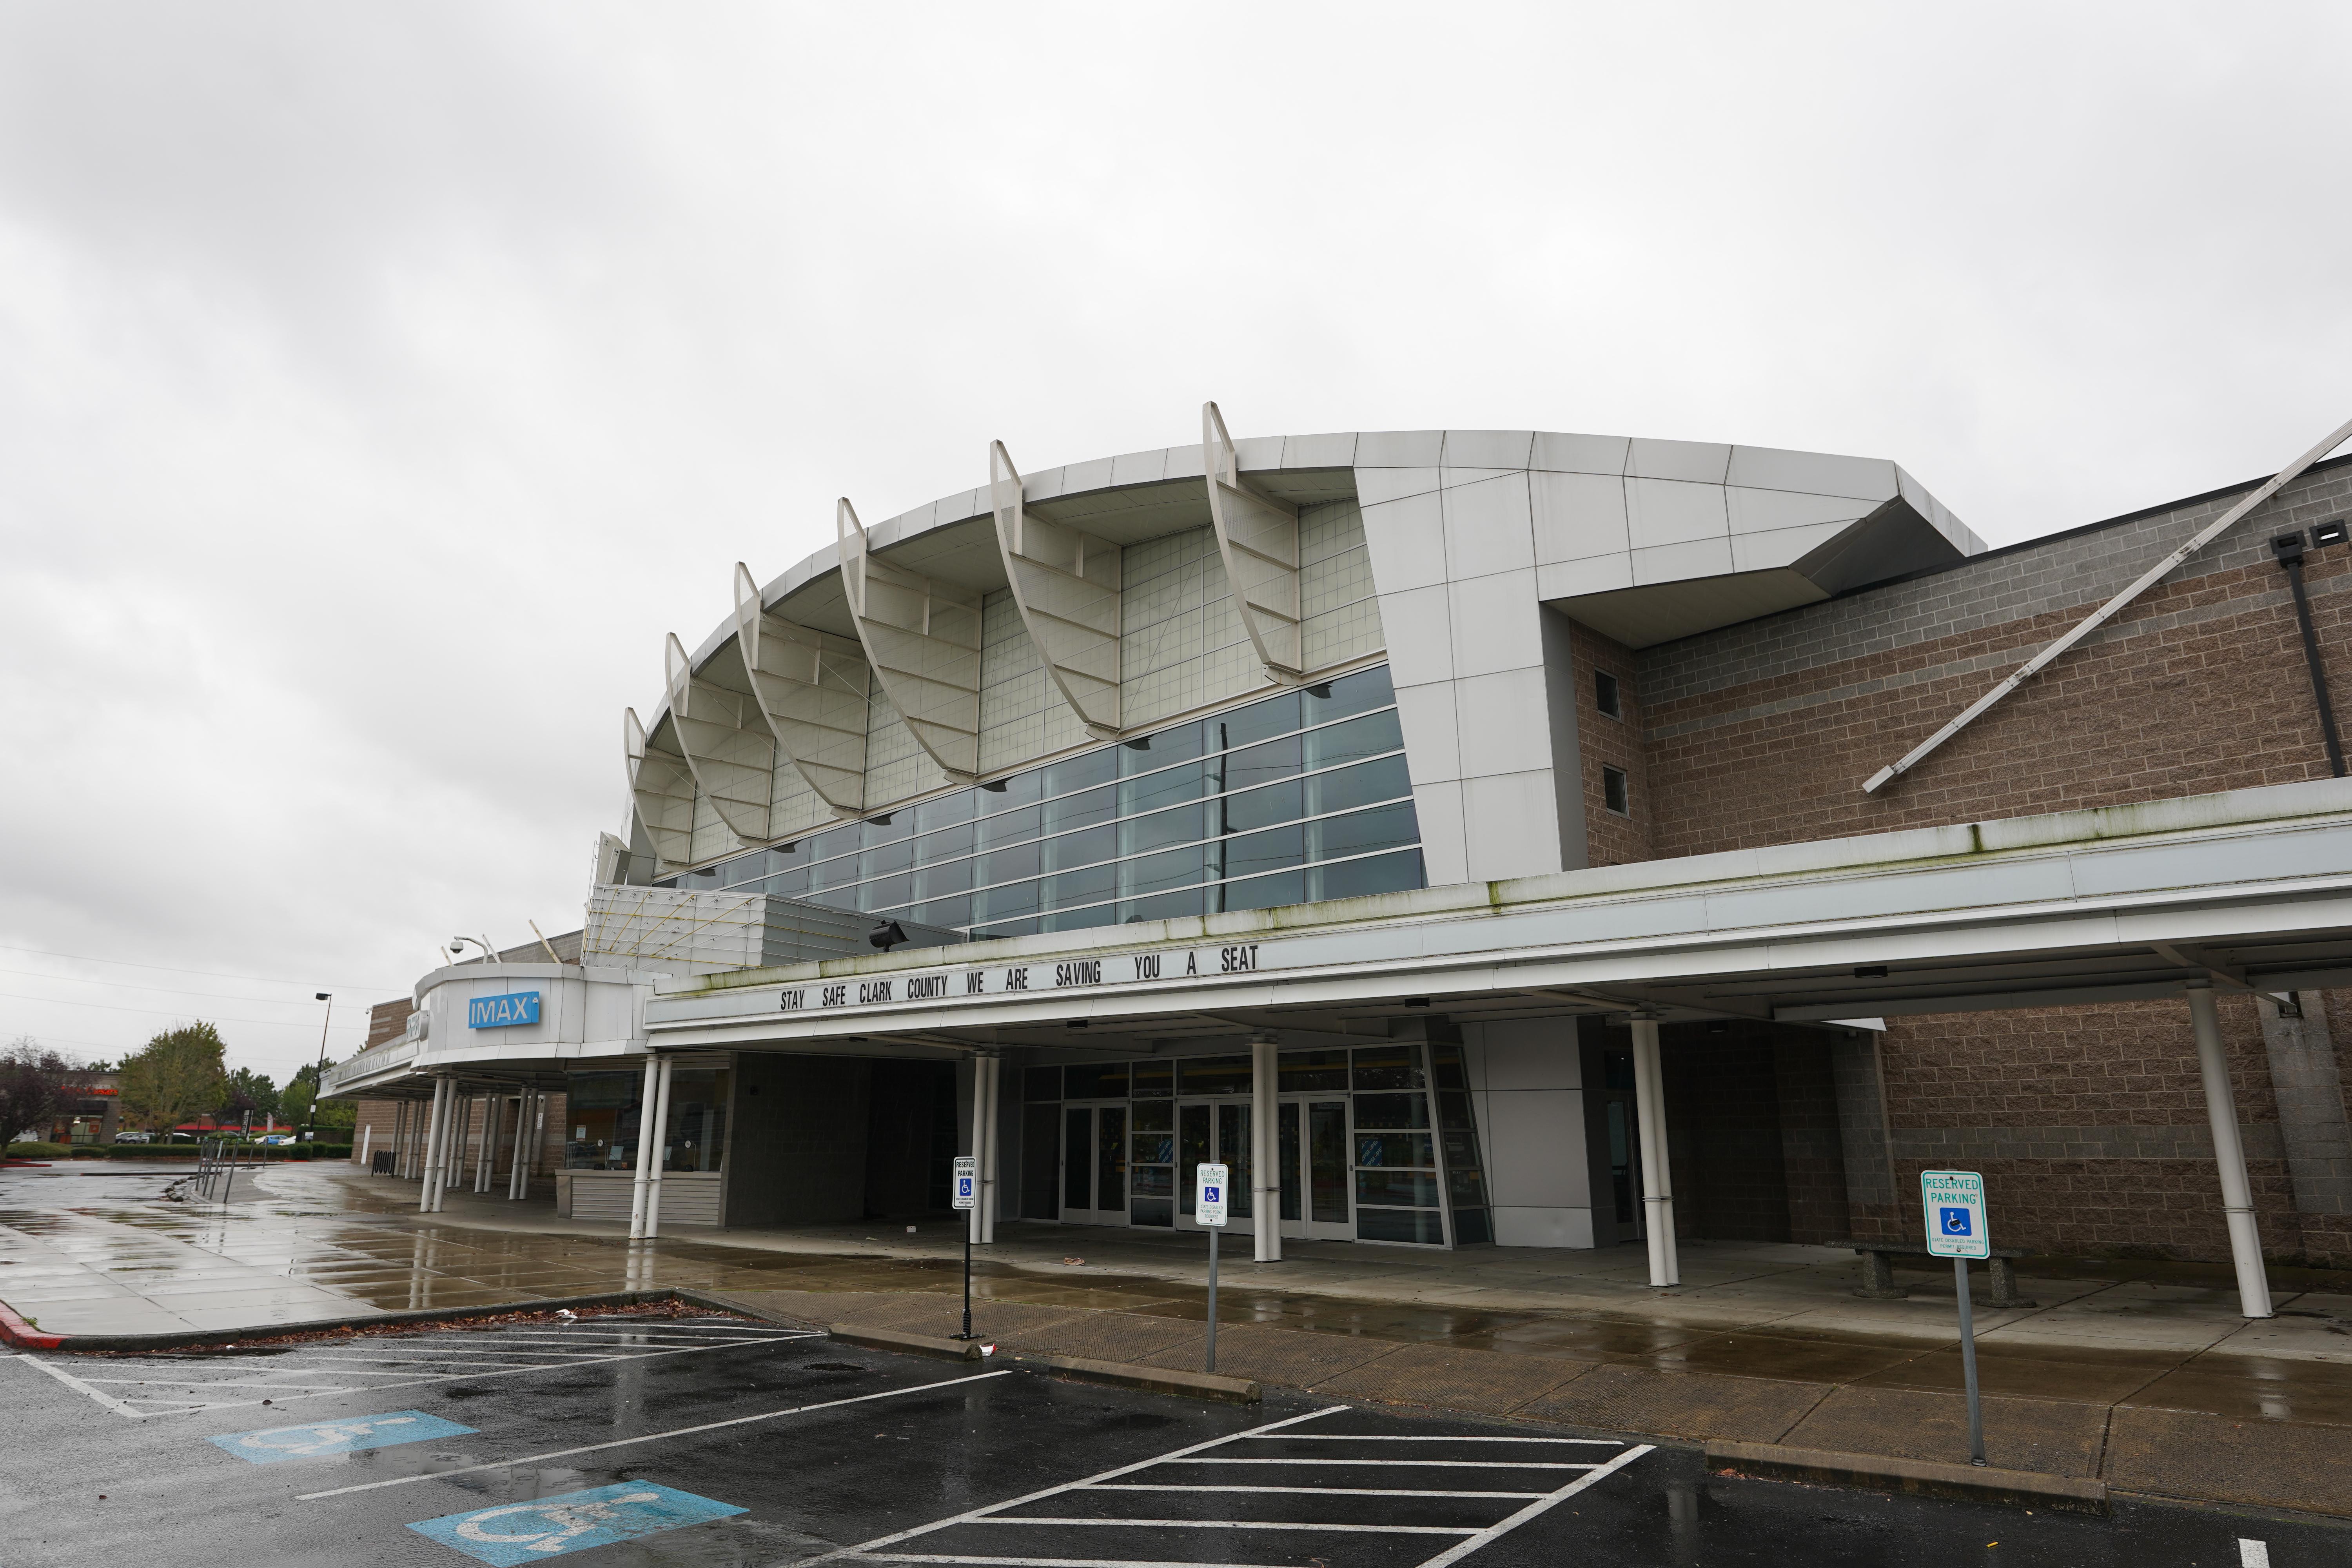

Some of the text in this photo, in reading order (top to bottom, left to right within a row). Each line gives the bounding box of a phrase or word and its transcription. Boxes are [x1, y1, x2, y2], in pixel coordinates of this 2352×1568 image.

[781, 945, 1258, 1010] STAY SAFE CLARK COUNTY WE ARE SAVING YOU A SEAT
[471, 997, 528, 1024] IMAX
[407, 1013, 420, 1039] RPX
[1926, 1178, 1978, 1190] RESERVED
[1931, 1192, 1976, 1204] PARKING
